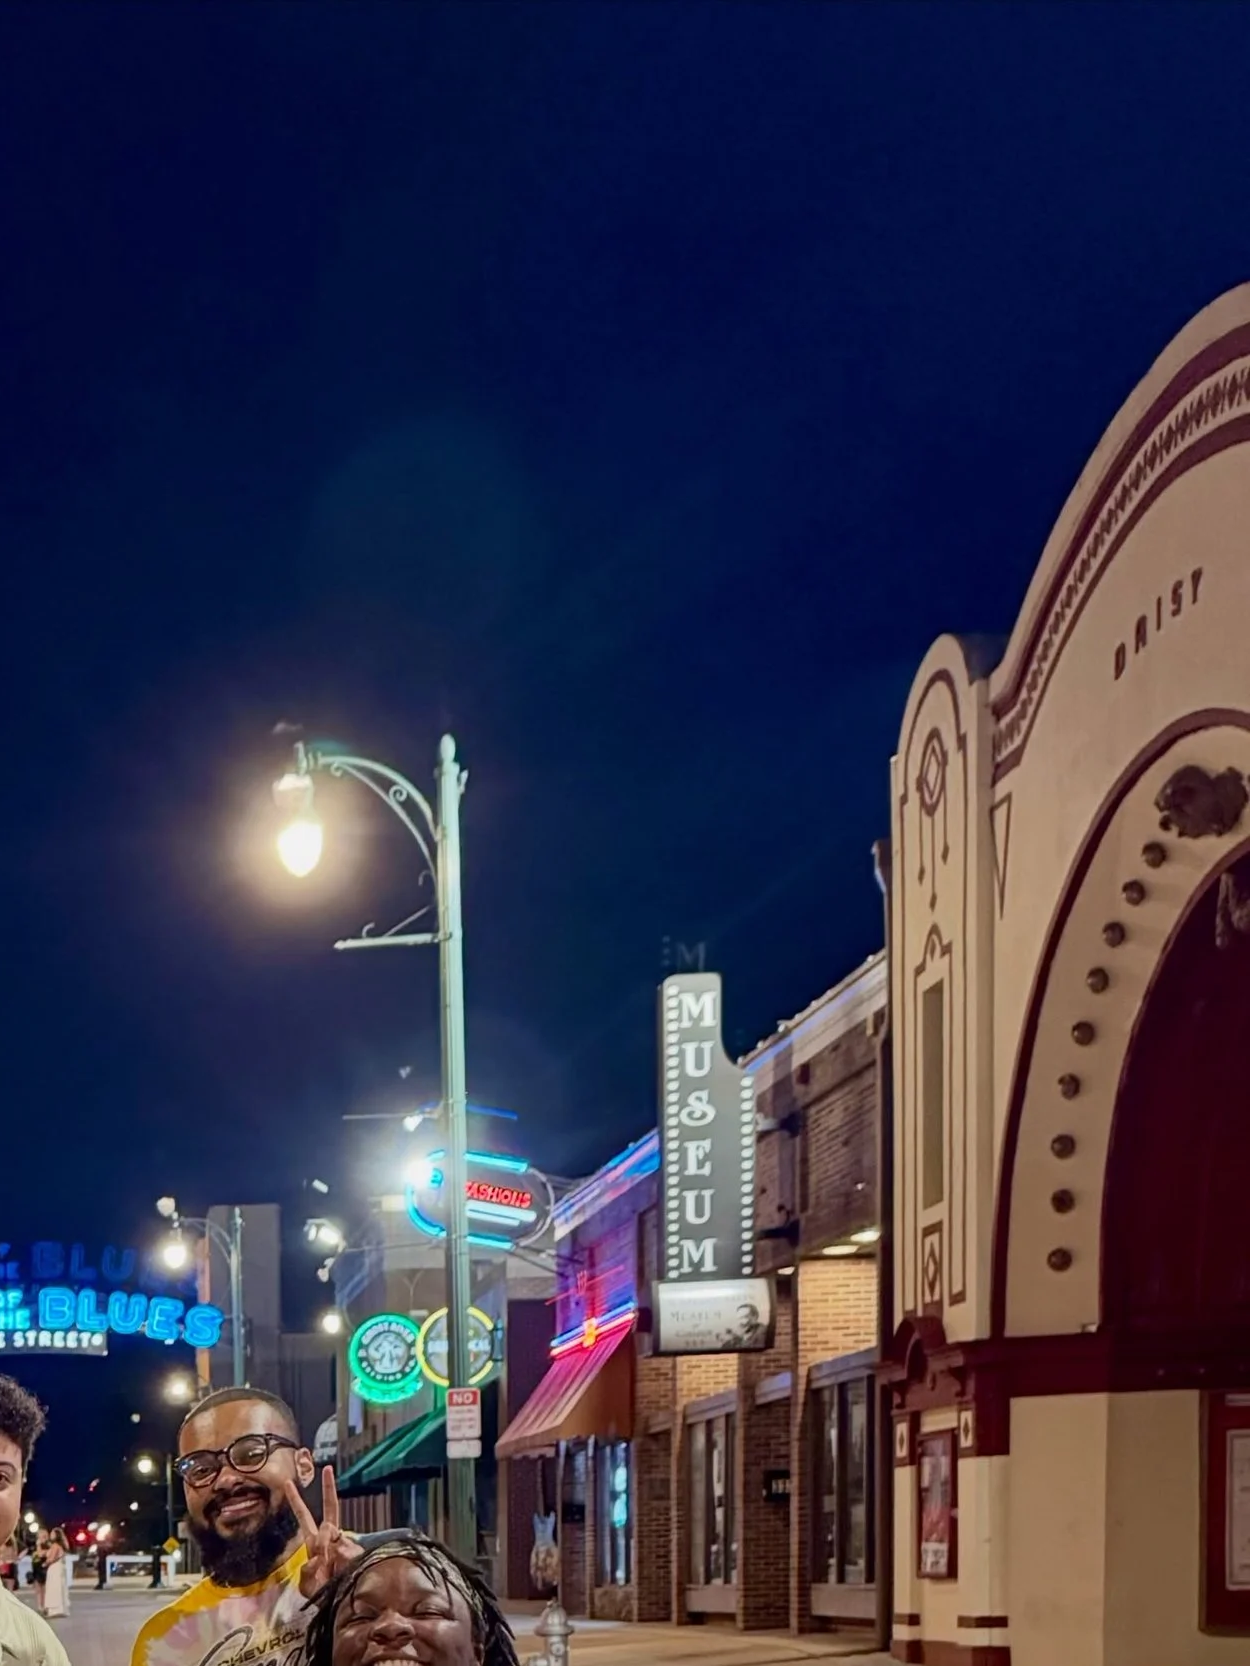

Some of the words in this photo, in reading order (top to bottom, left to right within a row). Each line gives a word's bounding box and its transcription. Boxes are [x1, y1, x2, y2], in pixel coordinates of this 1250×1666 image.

[1114, 566, 1203, 681] DAISY
[678, 991, 718, 1274] MUSEUM
[13, 1330, 93, 1348] STREET
[38, 1287, 224, 1349] BLUES
[452, 1391, 474, 1405] NO
